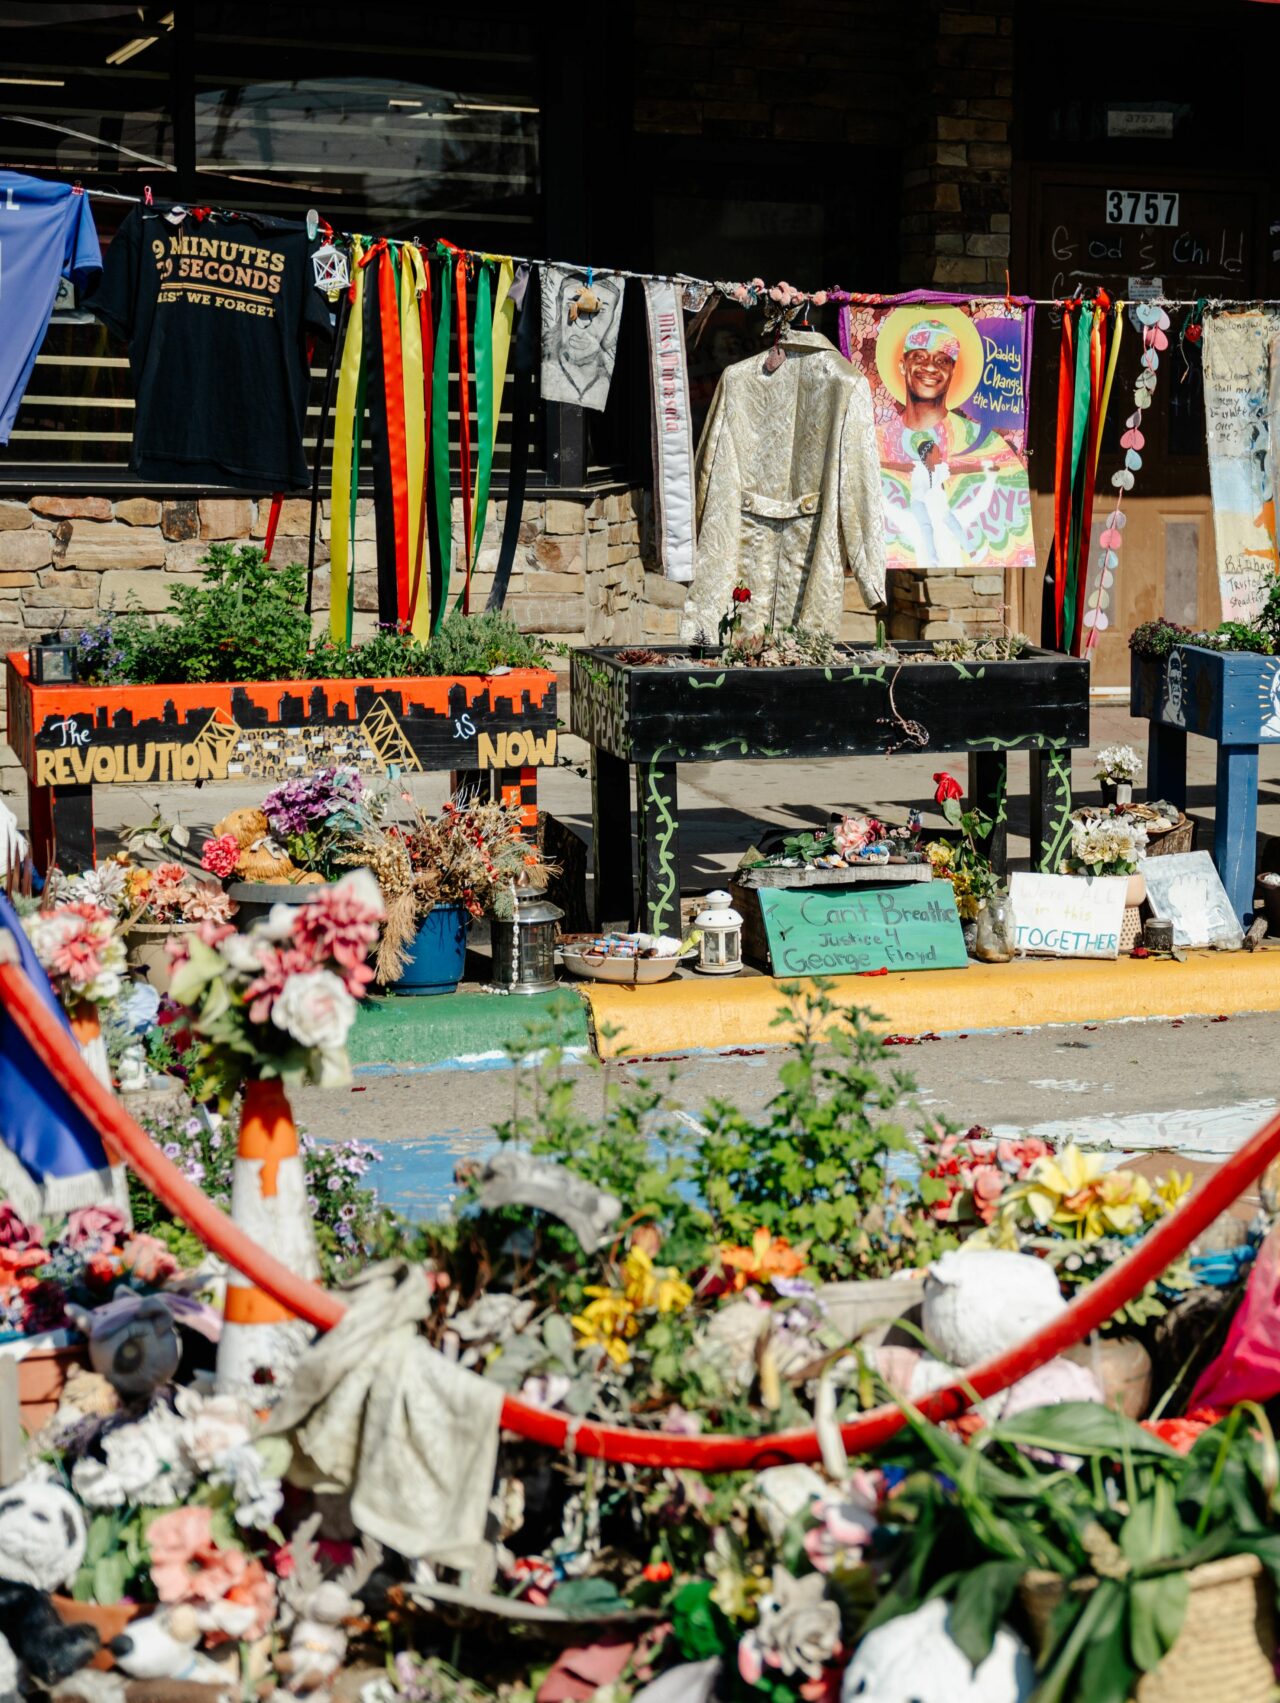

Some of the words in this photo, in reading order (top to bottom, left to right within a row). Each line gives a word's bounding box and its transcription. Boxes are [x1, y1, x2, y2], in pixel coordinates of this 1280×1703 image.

[1109, 193, 1177, 224] 3757
[152, 239, 165, 259] 9
[169, 236, 286, 272] MINUTES
[1172, 229, 1245, 273] Child
[178, 257, 282, 294] SECONDS
[187, 292, 211, 305] WE
[214, 296, 277, 318] FORGET
[983, 335, 1022, 373] Daddy
[972, 392, 988, 409] the
[50, 719, 92, 747] The
[35, 740, 231, 788] REVOLUTION
[478, 729, 557, 769] NOW
[818, 931, 884, 948] Justice
[885, 927, 900, 946] 4
[1016, 926, 1118, 951] TOGETHER
[783, 948, 872, 973] George
[885, 945, 937, 965] Floyd
